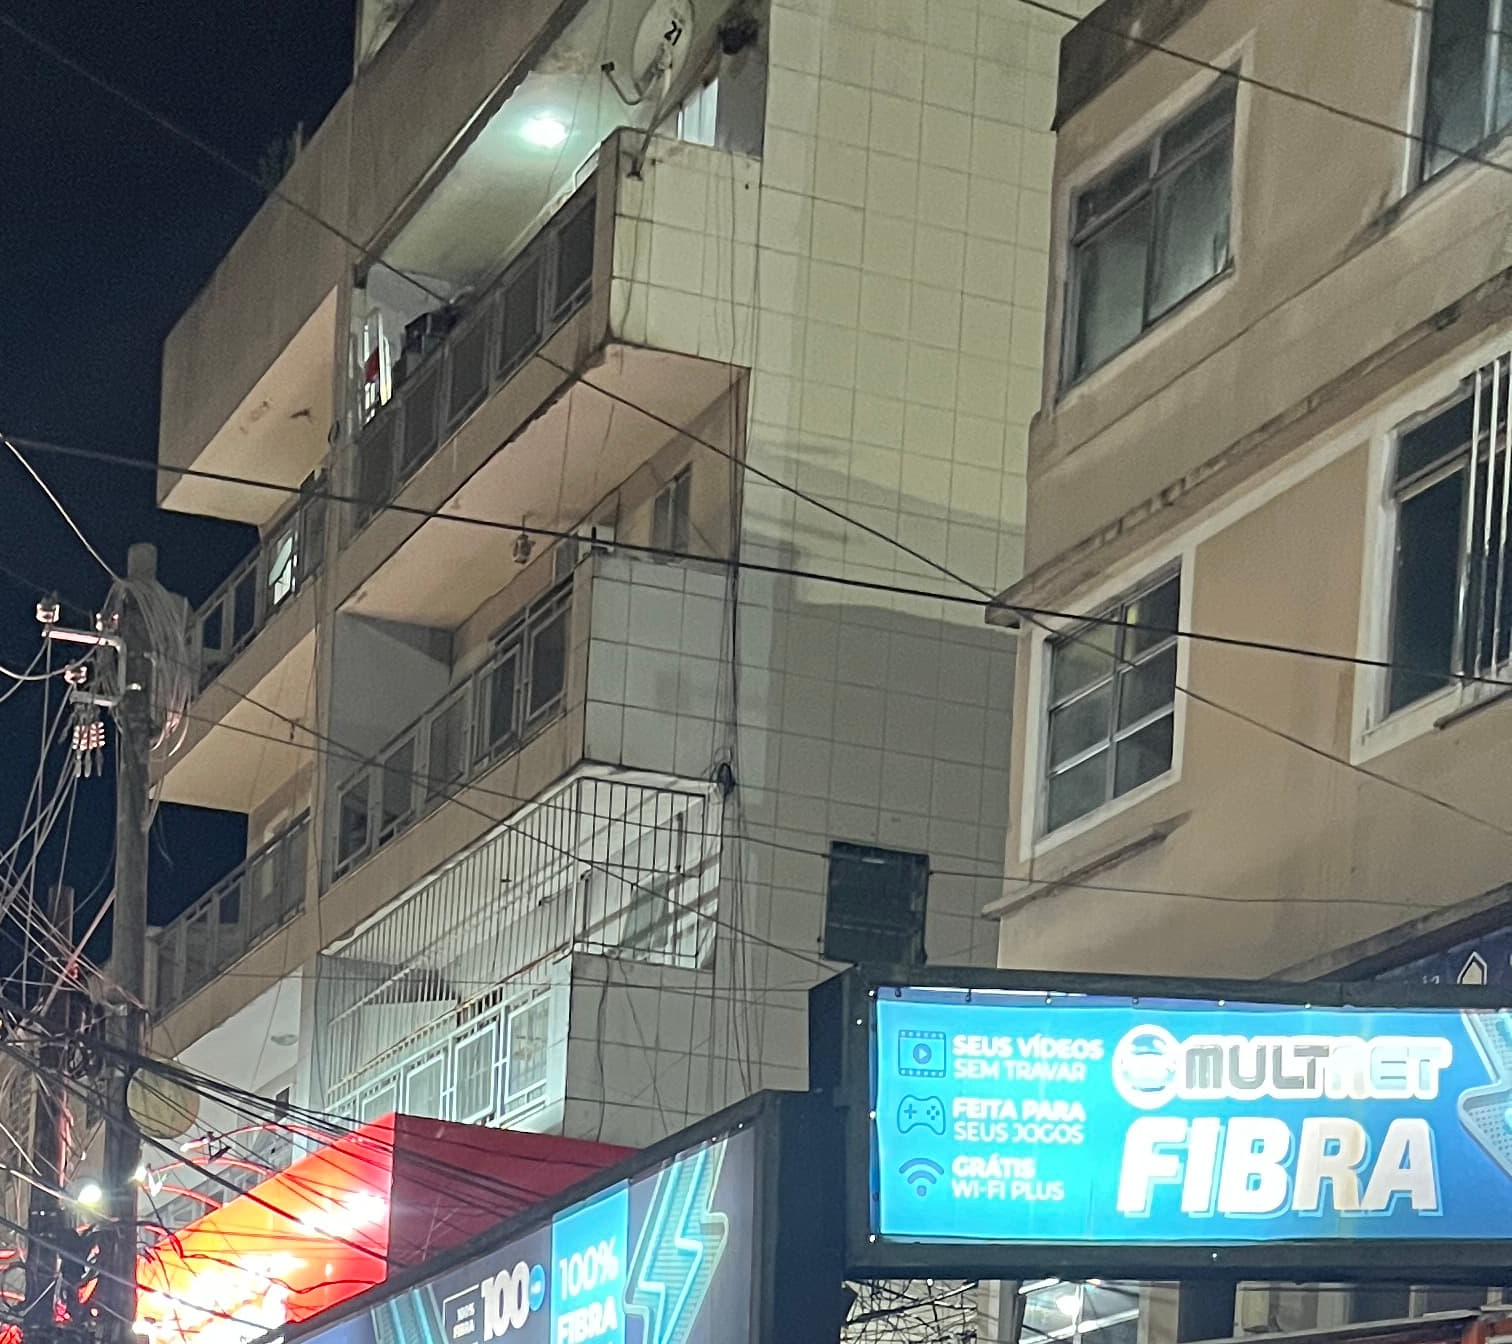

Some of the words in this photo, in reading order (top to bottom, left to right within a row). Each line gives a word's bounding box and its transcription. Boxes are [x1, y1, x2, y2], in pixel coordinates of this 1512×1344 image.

[952, 1034, 1013, 1058] SEUS
[1017, 1033, 1105, 1060] VÍDEOS
[953, 1059, 1000, 1079] SEM
[1005, 1061, 1087, 1082] TRAVAR
[1182, 1038, 1450, 1098] MULTNET
[952, 1097, 1017, 1121] FEITA
[1022, 1099, 1086, 1122] PARA
[953, 1122, 1009, 1142] SEUS
[1012, 1124, 1085, 1145] JOGOS
[952, 1153, 1037, 1179] GRÁTIS
[1117, 1117, 1441, 1216] FIBRA
[952, 1180, 1006, 1199] WI-FI
[1011, 1181, 1065, 1201] PLUS
[559, 1236, 620, 1300] 100%
[481, 1261, 530, 1341] 100
